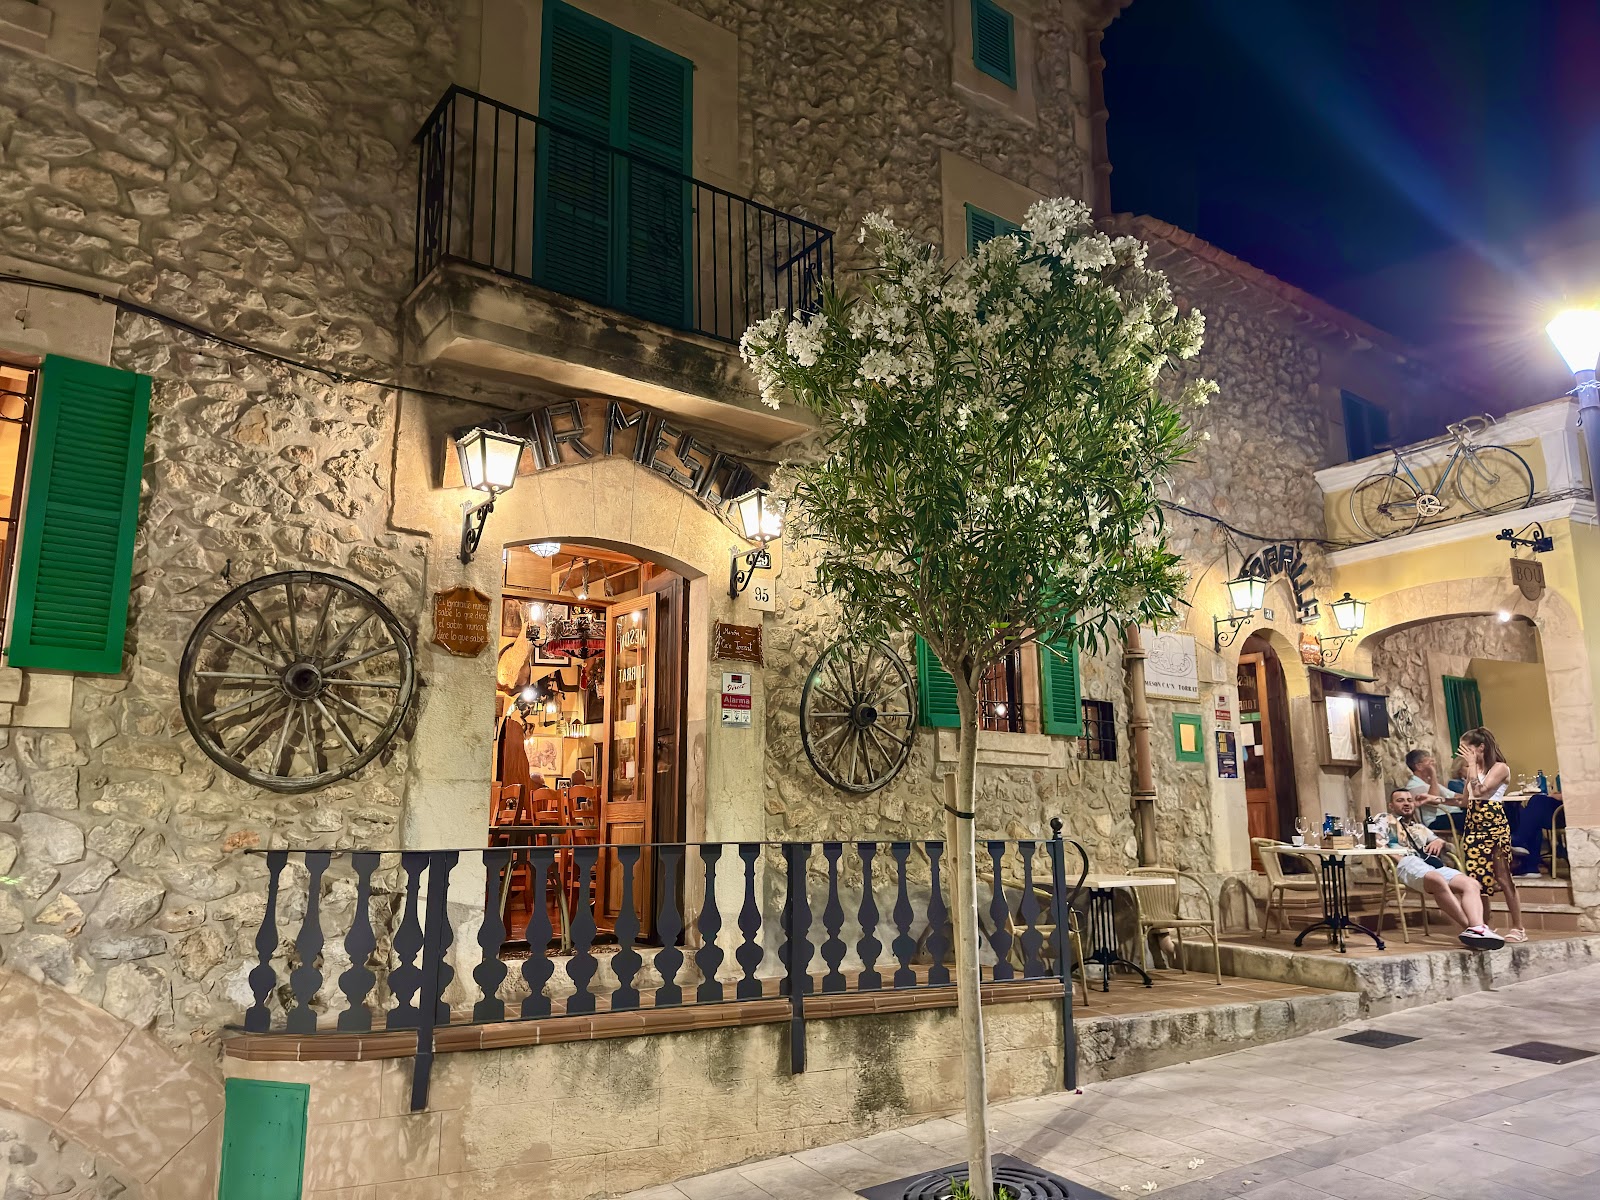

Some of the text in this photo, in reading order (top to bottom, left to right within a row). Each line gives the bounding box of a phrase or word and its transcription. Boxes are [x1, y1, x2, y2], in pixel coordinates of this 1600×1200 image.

[1516, 566, 1542, 583] BOU
[437, 595, 446, 606] El
[754, 586, 770, 602] 95
[437, 608, 453, 617] sabe
[455, 609, 462, 617] lo
[438, 618, 485, 632] el sabio nunca
[436, 630, 485, 644] dice lo que sabe
[723, 695, 751, 705] Alarma
